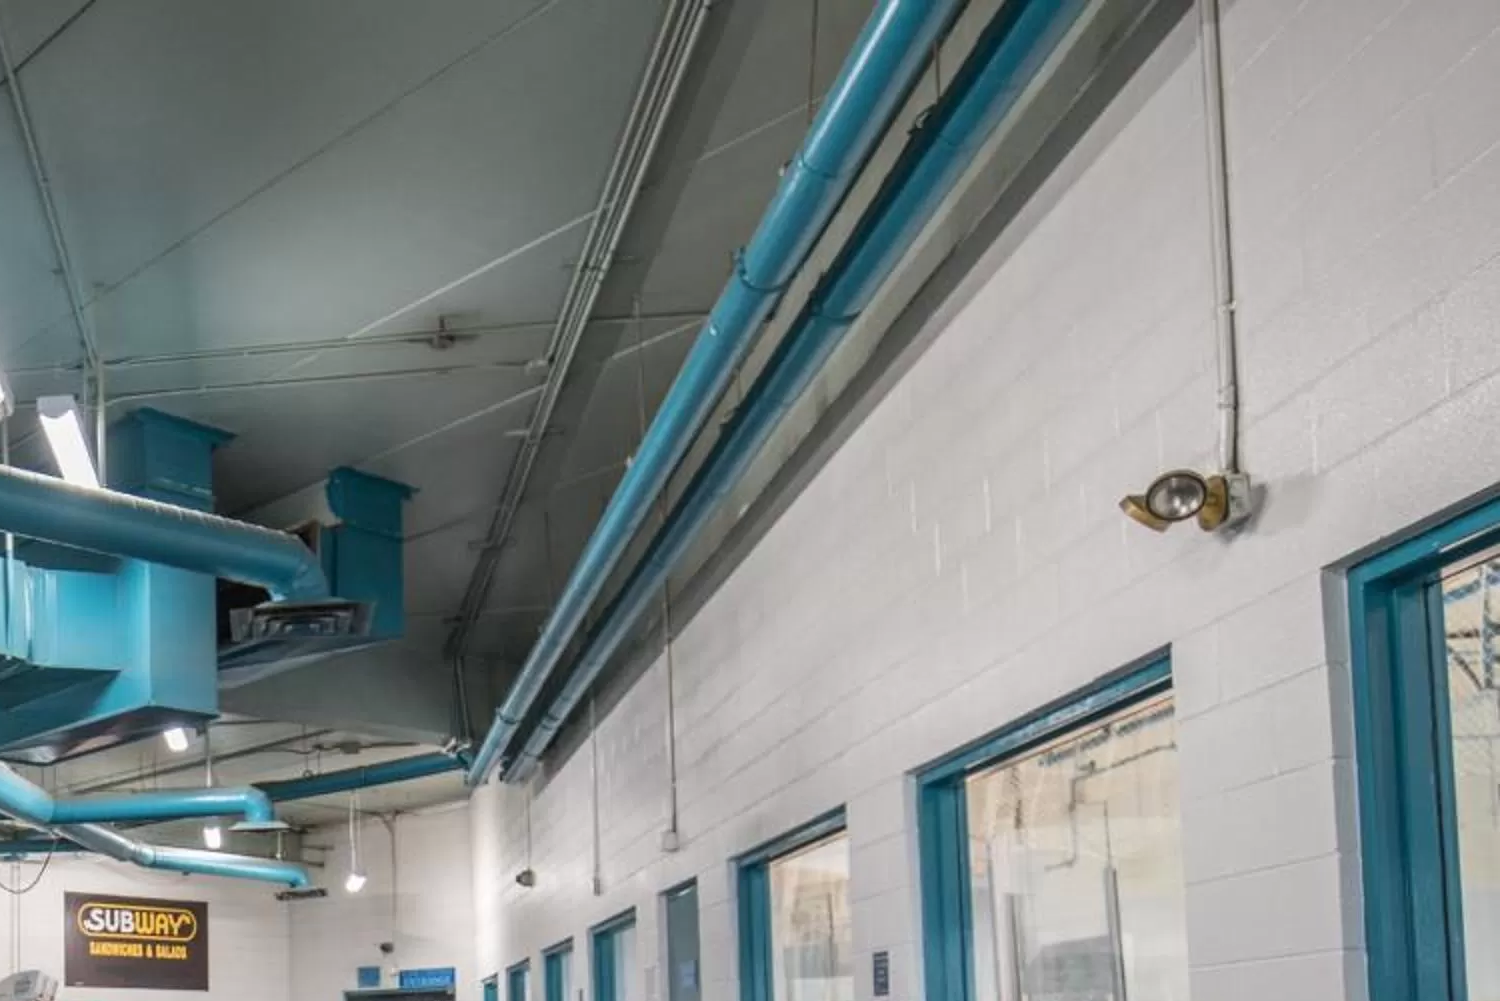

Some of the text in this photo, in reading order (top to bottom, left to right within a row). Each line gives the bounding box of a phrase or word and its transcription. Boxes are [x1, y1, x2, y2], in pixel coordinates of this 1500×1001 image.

[83, 908, 191, 936] SUBWAY
[89, 941, 187, 959] SANDWICHES & SALADS
